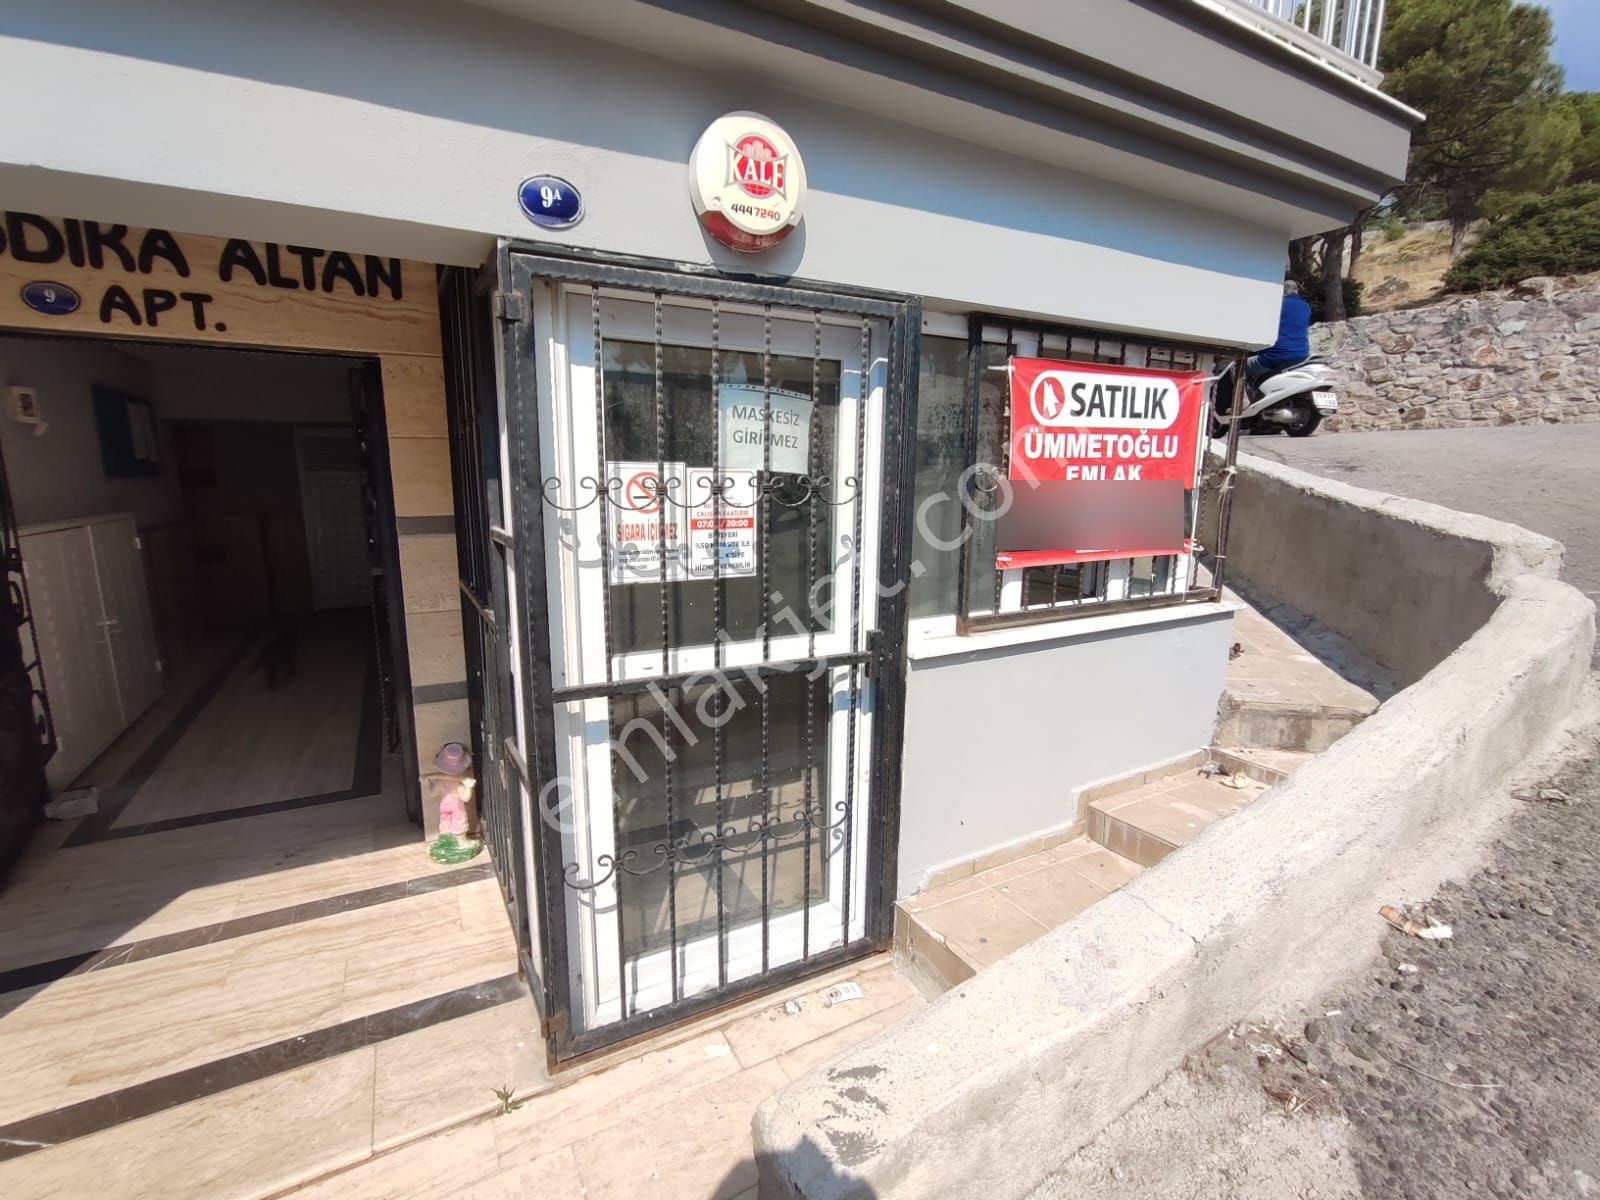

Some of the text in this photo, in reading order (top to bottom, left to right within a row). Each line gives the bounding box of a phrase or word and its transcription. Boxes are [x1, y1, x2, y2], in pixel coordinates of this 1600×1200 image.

[729, 150, 787, 193] KALE
[540, 185, 563, 209] 9A
[0, 210, 403, 300] DIKA ALTAN
[44, 288, 56, 304] 9
[99, 285, 228, 332] APT.
[1070, 382, 1169, 420] SATILIK
[732, 405, 800, 426] MASKESİZ
[733, 427, 798, 449] GİRİMEZ
[1024, 427, 1178, 459] ÜMMETOĞLU
[617, 519, 646, 543] SİGARA
[647, 518, 678, 545] İÇİEZ
[696, 520, 719, 529] 07:0
[726, 519, 749, 528] 20:00
[695, 561, 718, 572] HİZME
